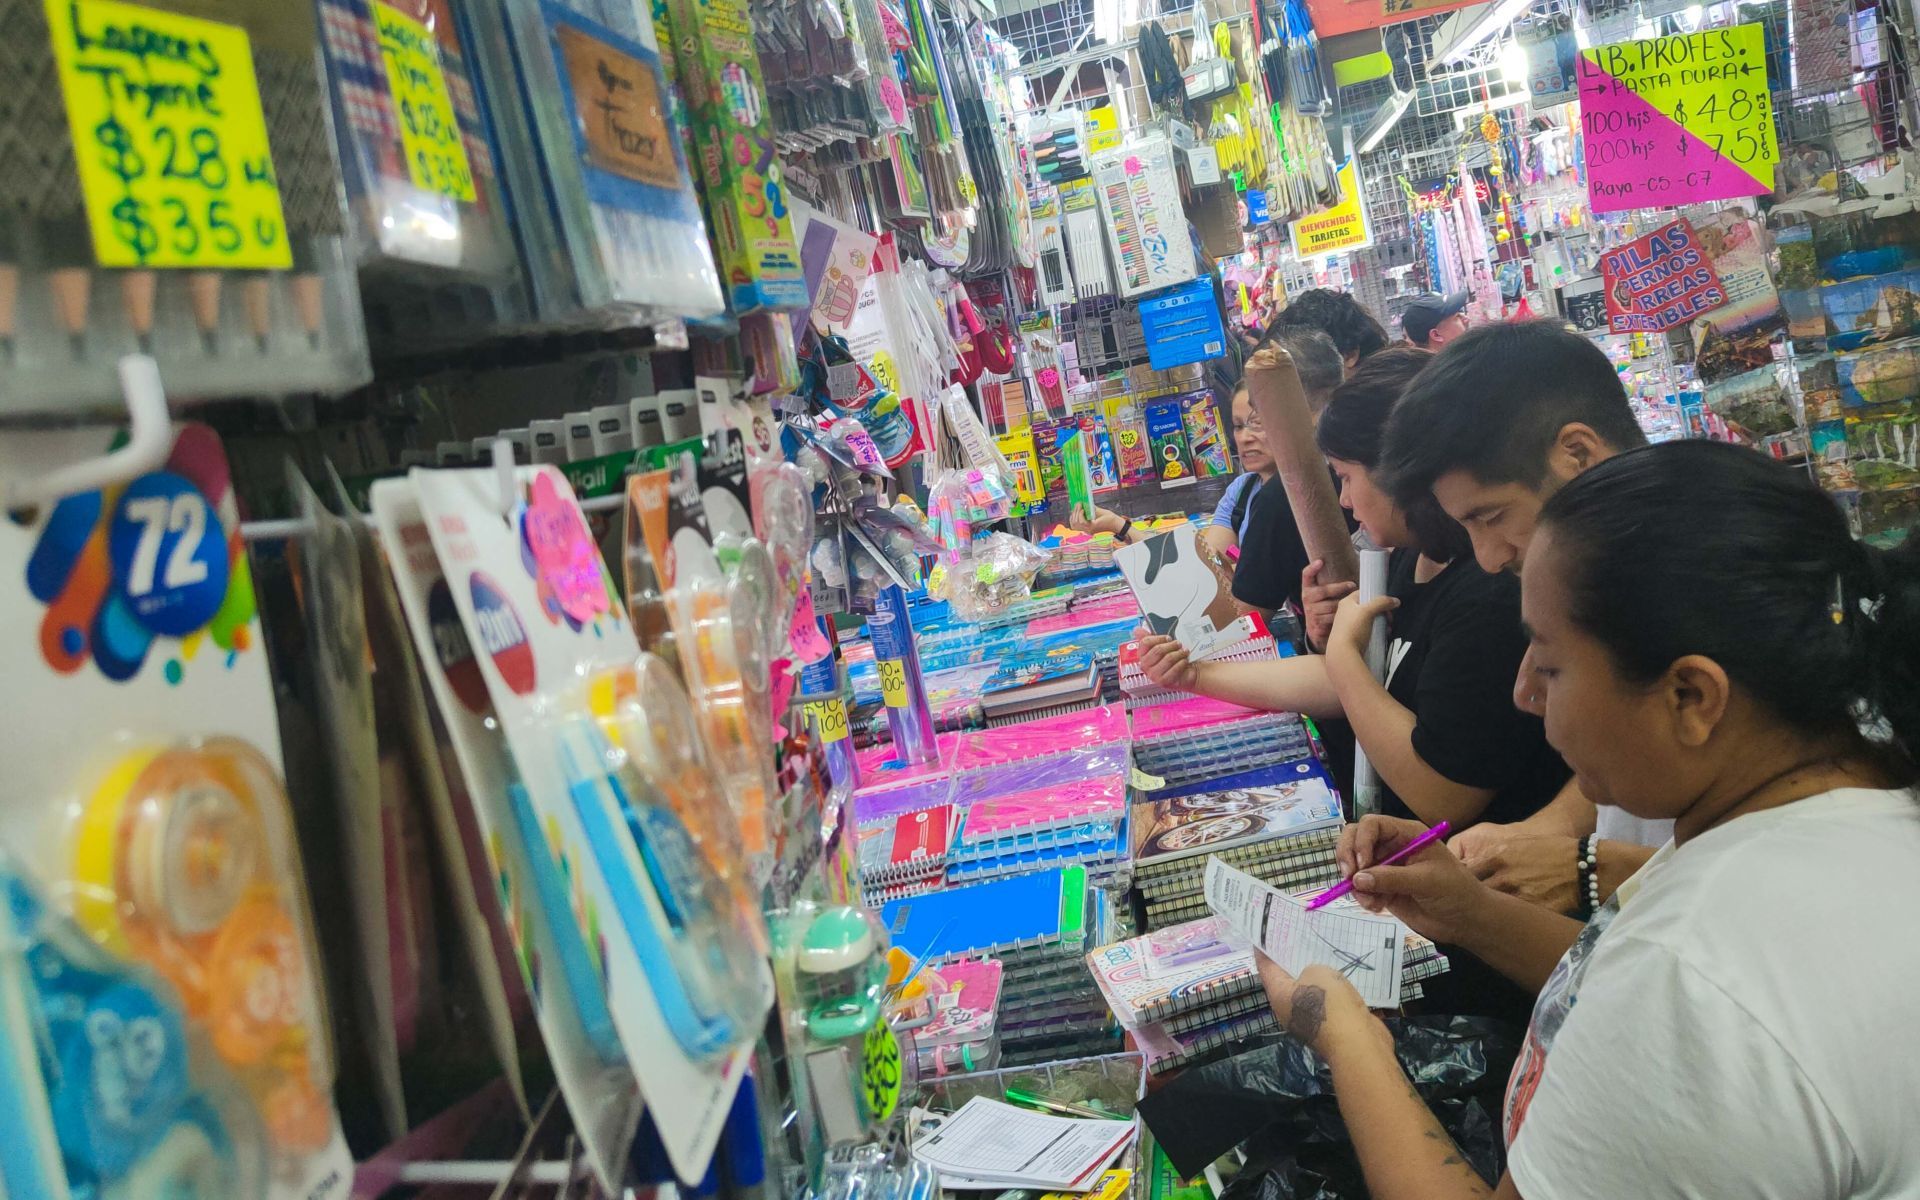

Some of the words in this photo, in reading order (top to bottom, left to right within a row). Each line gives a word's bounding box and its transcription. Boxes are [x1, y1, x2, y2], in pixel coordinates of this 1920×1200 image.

[1611, 72, 1671, 97] PASTA
[1681, 63, 1738, 85] DURA
[1593, 180, 1633, 198] Raya
[1300, 213, 1357, 234] BIENVENIDAS
[1310, 227, 1350, 244] TARJETAS
[1607, 226, 1690, 278] PILAS
[126, 492, 208, 597] 72
